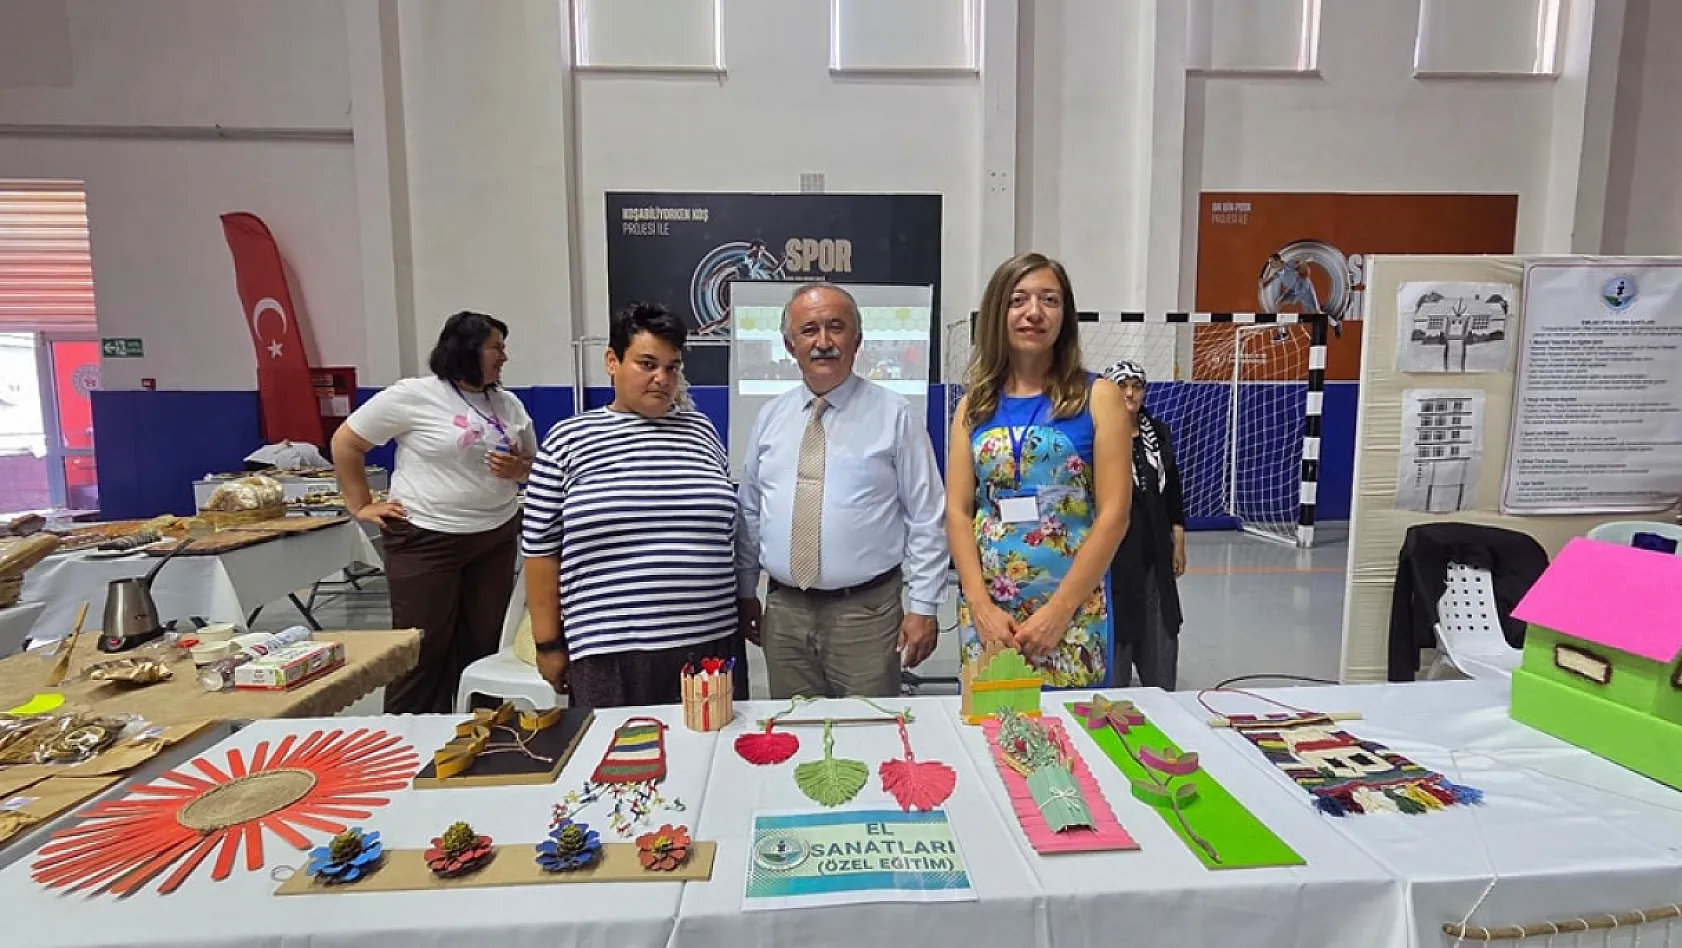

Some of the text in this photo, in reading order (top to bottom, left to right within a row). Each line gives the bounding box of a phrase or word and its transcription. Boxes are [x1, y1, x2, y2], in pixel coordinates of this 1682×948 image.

[785, 238, 852, 273] SPOR
[867, 822, 894, 836] EL
[810, 840, 956, 858] SANATLARI
[817, 856, 955, 875] (ÖZEL EĞİTİM)
